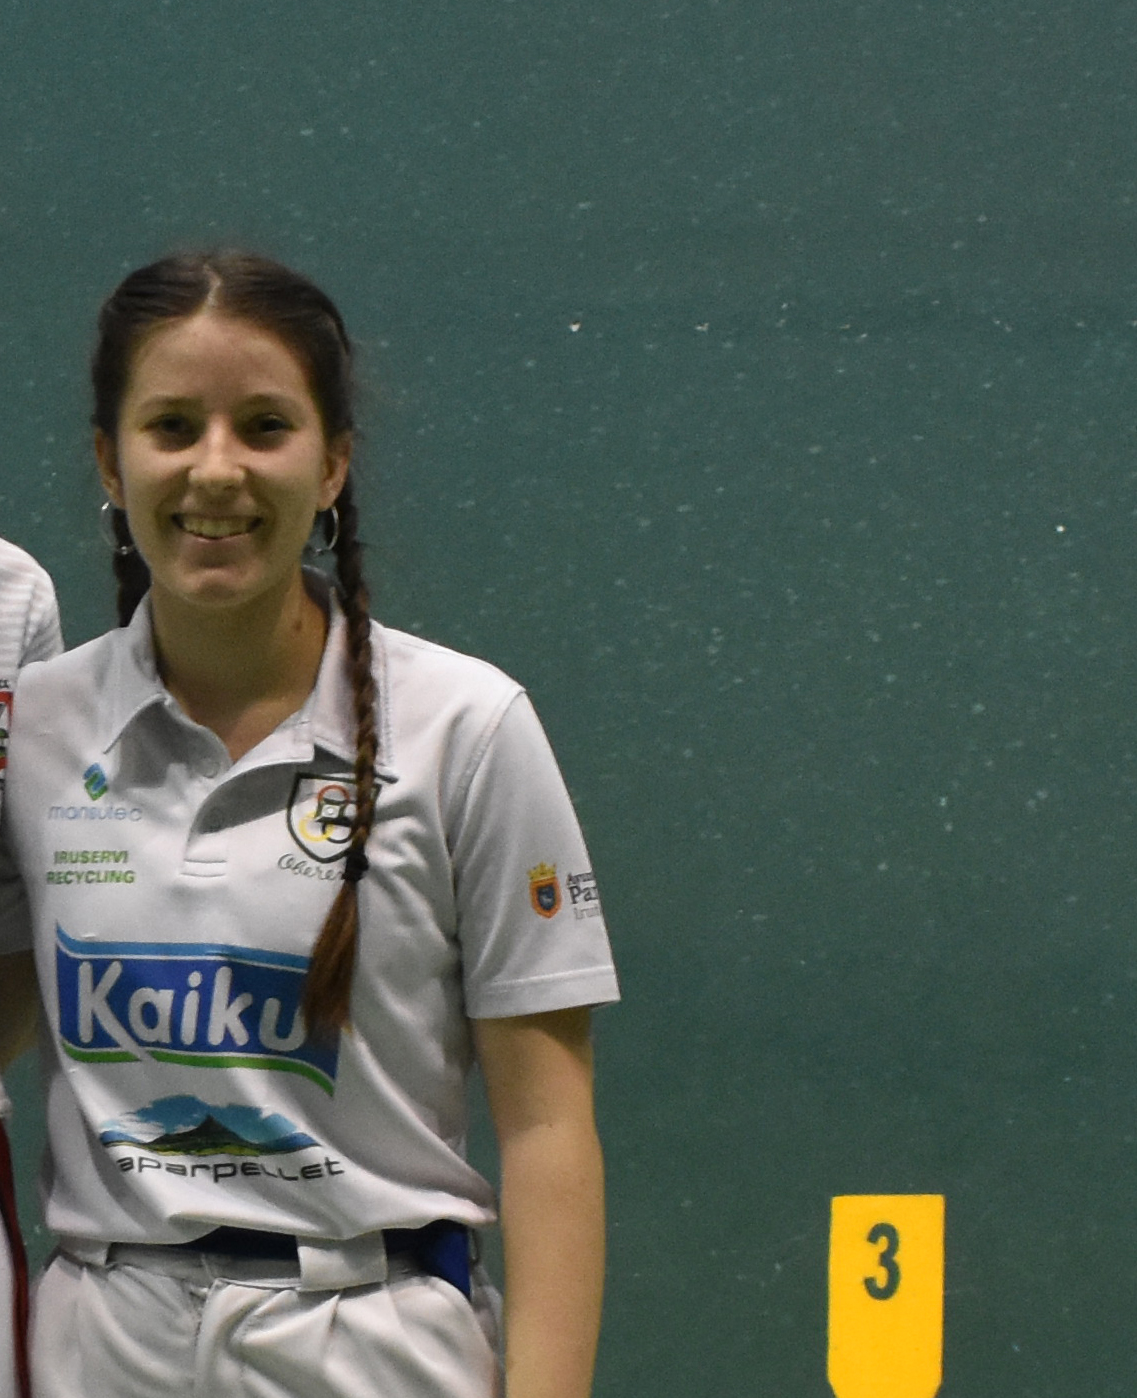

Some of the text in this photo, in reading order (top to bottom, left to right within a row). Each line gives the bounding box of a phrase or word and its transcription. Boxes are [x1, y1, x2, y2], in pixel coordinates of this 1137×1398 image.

[46, 870, 136, 885] RECYCLING
[77, 960, 307, 1062] Kaiku
[863, 1222, 901, 1301] 3
